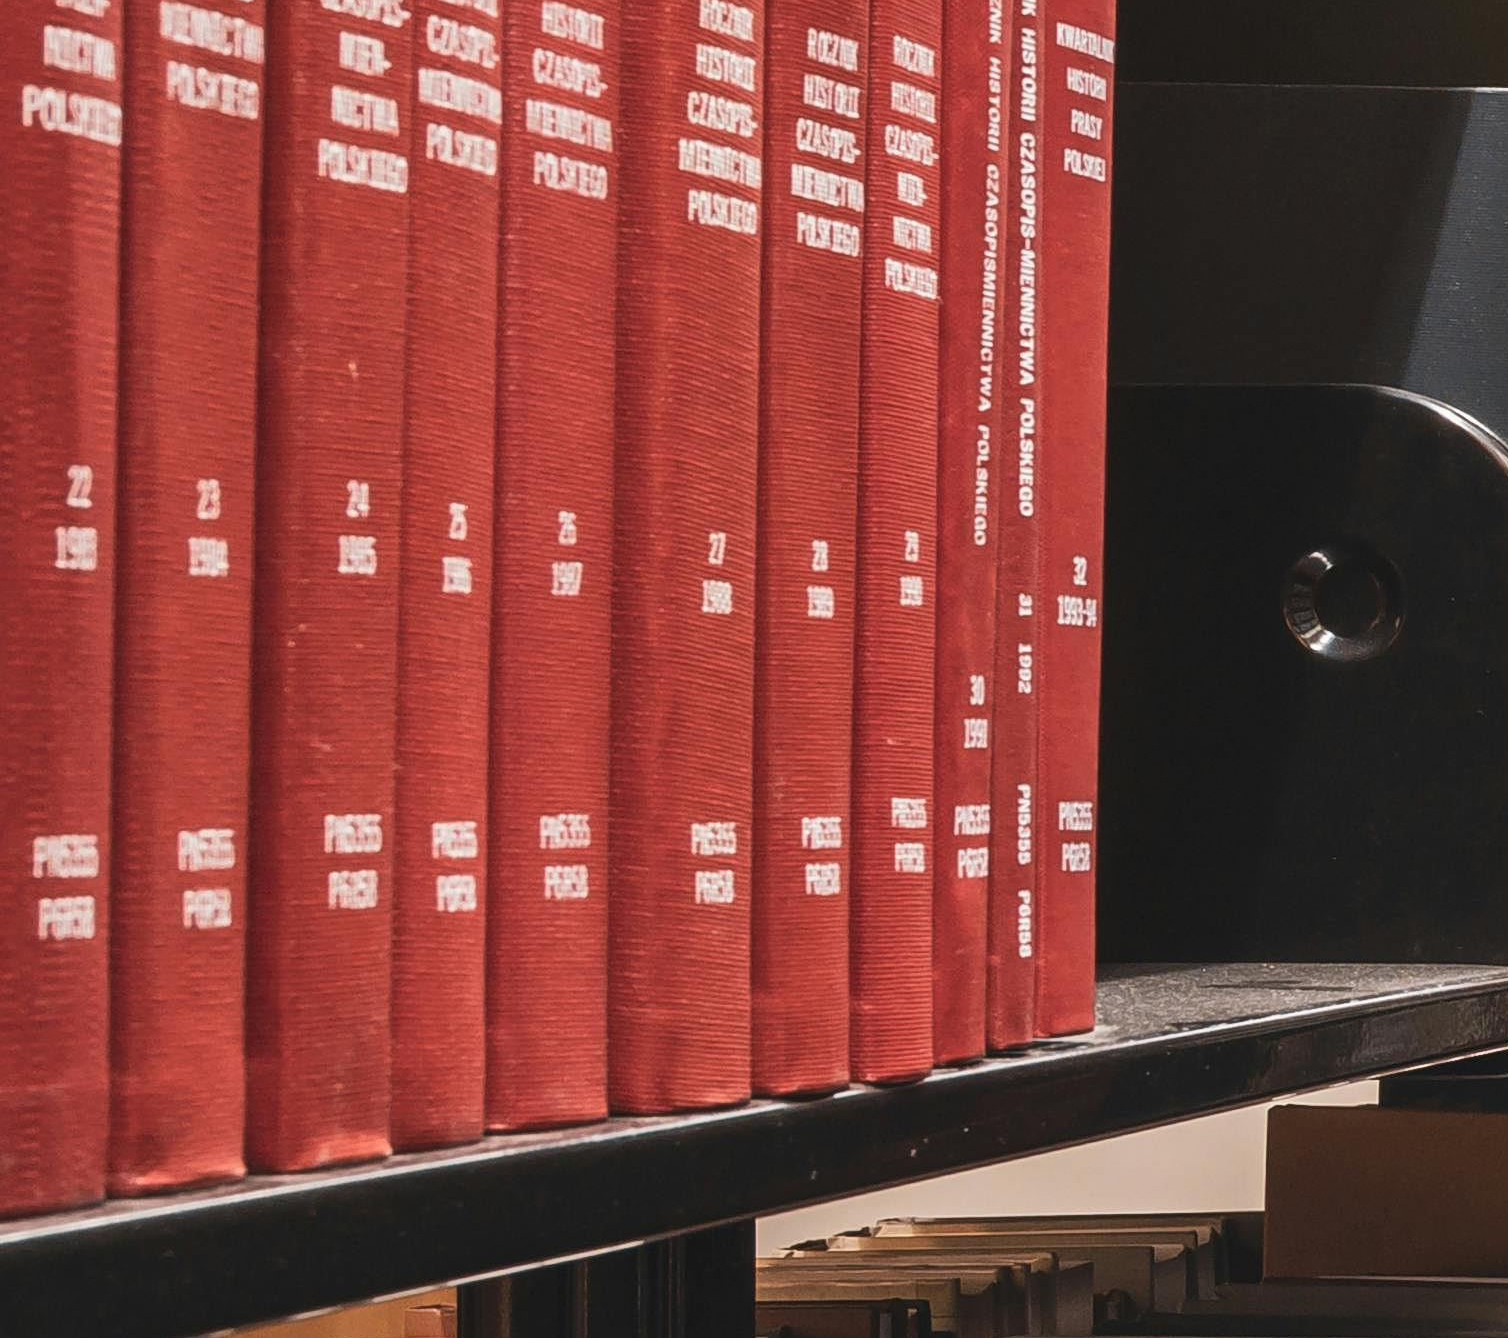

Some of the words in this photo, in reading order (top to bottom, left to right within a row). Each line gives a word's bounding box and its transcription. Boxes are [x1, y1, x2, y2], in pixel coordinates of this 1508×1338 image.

[1020, 27, 1037, 122] HISTORII
[1056, 22, 1114, 64] KWARTALNIK
[986, 56, 1002, 152] HISTORII
[1070, 109, 1104, 140] PRASY
[974, 424, 990, 547] POLSKIEGO
[1018, 398, 1035, 517] POLSKIEGO
[1018, 642, 1033, 695] 1992
[1017, 783, 1032, 865] PN5355
